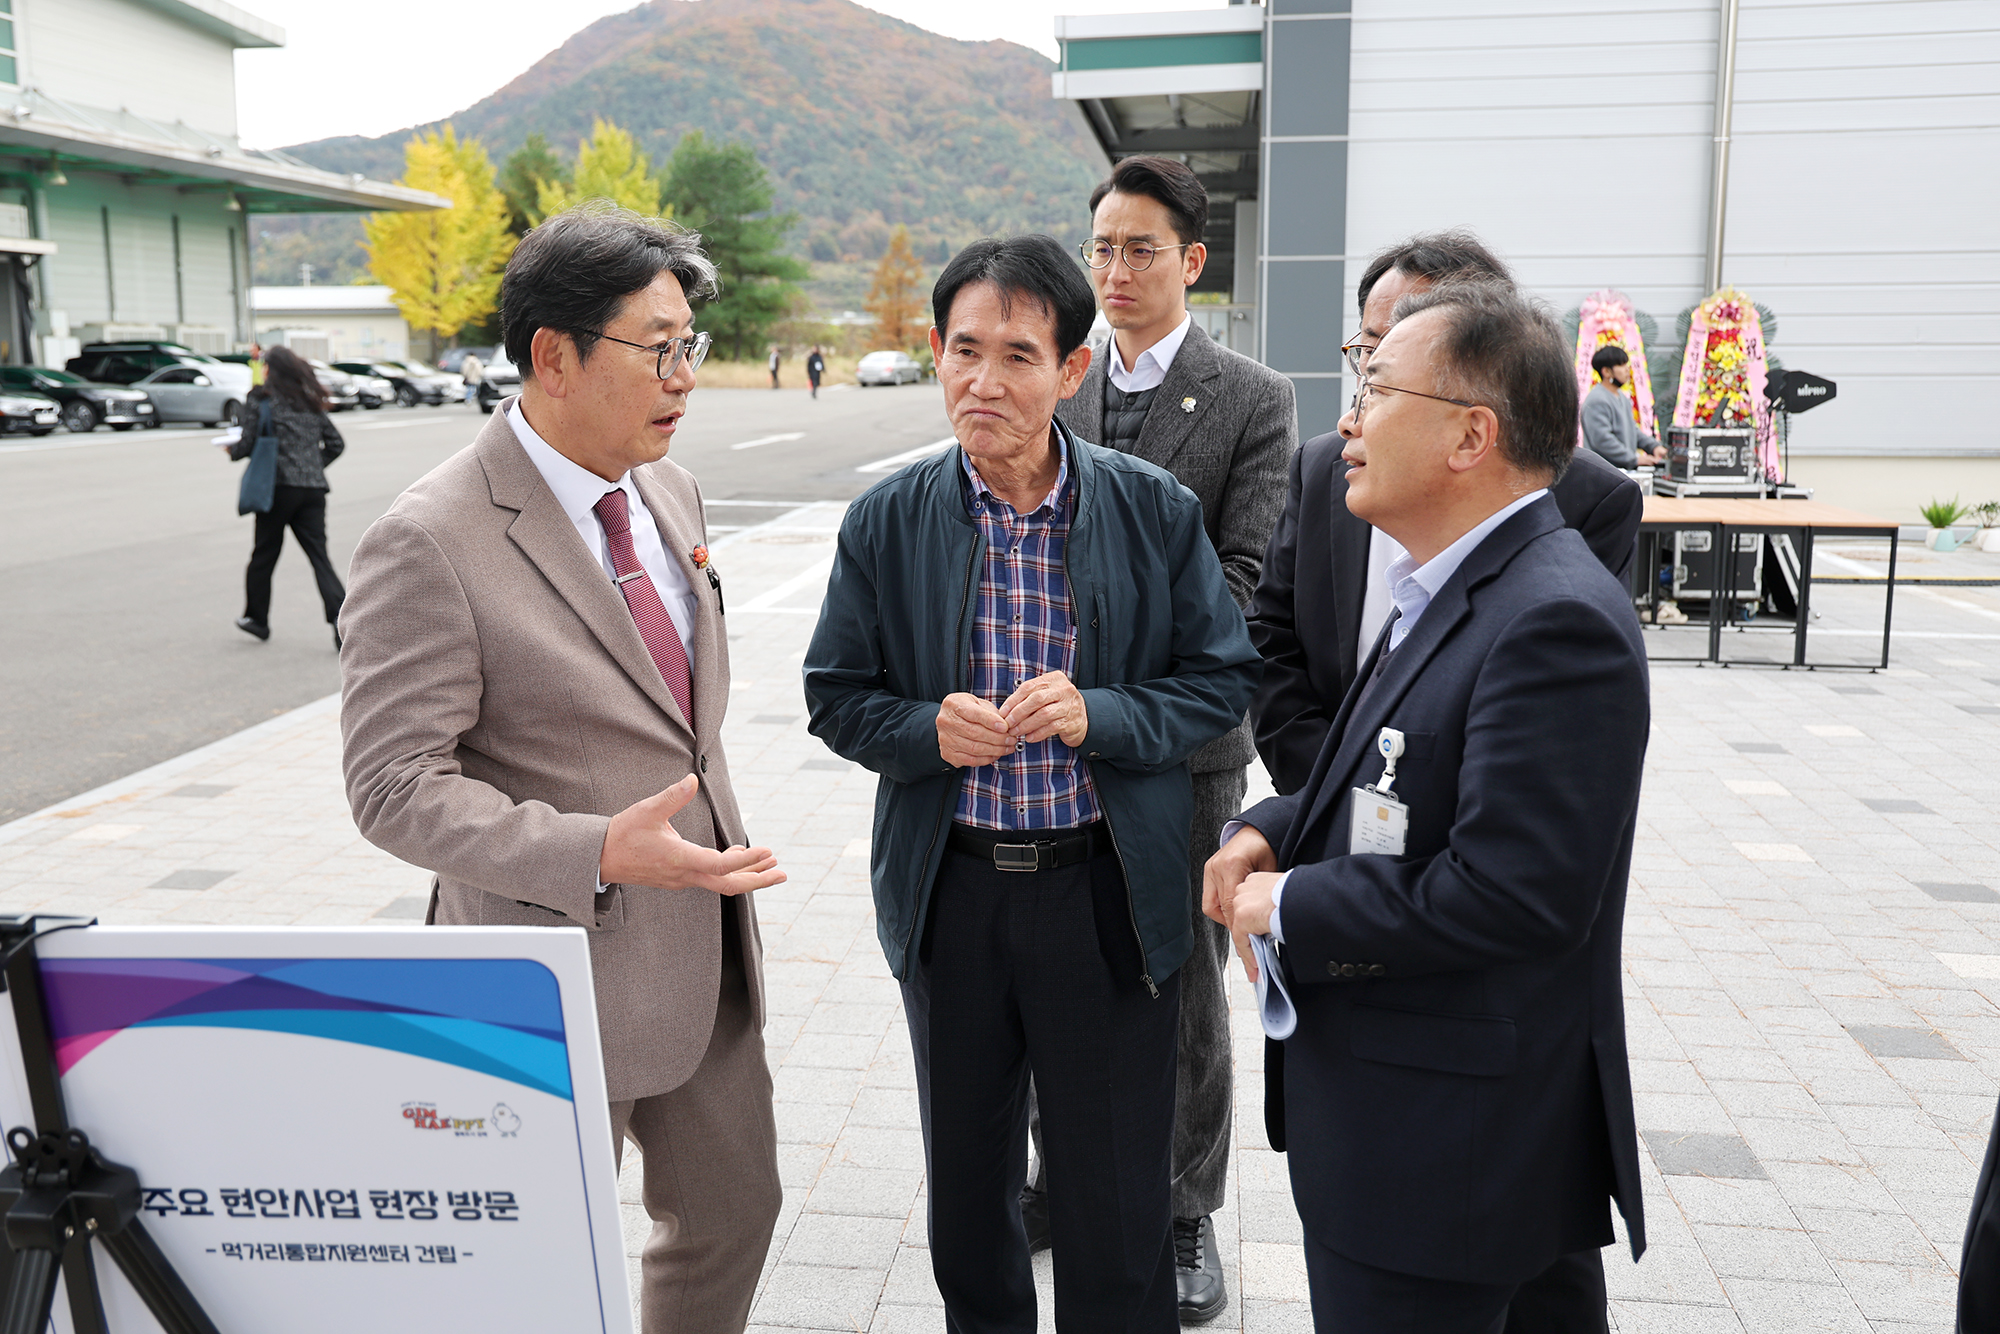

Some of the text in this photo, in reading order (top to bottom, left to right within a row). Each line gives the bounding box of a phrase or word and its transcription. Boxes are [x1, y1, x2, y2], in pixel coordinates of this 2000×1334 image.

[402, 1107, 438, 1120] GIM
[142, 1187, 520, 1222] 주요 현안사업 현장 방문
[221, 1242, 411, 1263] 먹거리통합지원센터
[414, 1244, 458, 1264] 건립
